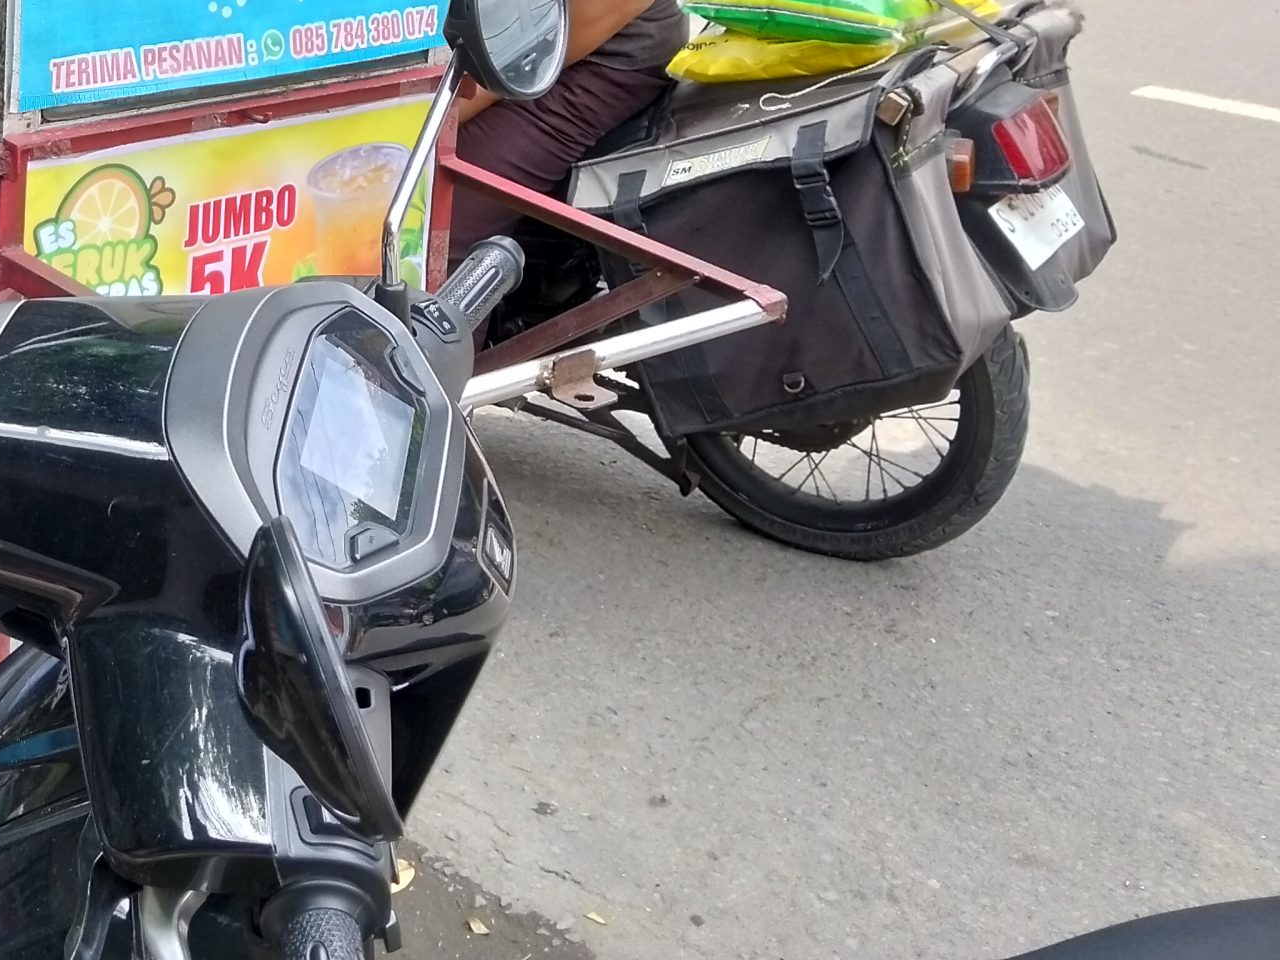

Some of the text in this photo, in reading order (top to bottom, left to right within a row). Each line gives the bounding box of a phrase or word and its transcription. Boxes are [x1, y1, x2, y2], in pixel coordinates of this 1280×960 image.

[51, 56, 137, 92] TERIMA
[291, 26, 327, 57] 085
[331, 19, 367, 50] 784
[369, 12, 402, 44] 380
[405, 6, 439, 38] 074
[671, 166, 692, 177] SM
[38, 220, 76, 252] ES
[183, 183, 297, 249] JUMBO
[44, 241, 151, 286] ERUK
[189, 240, 270, 295] 5K
